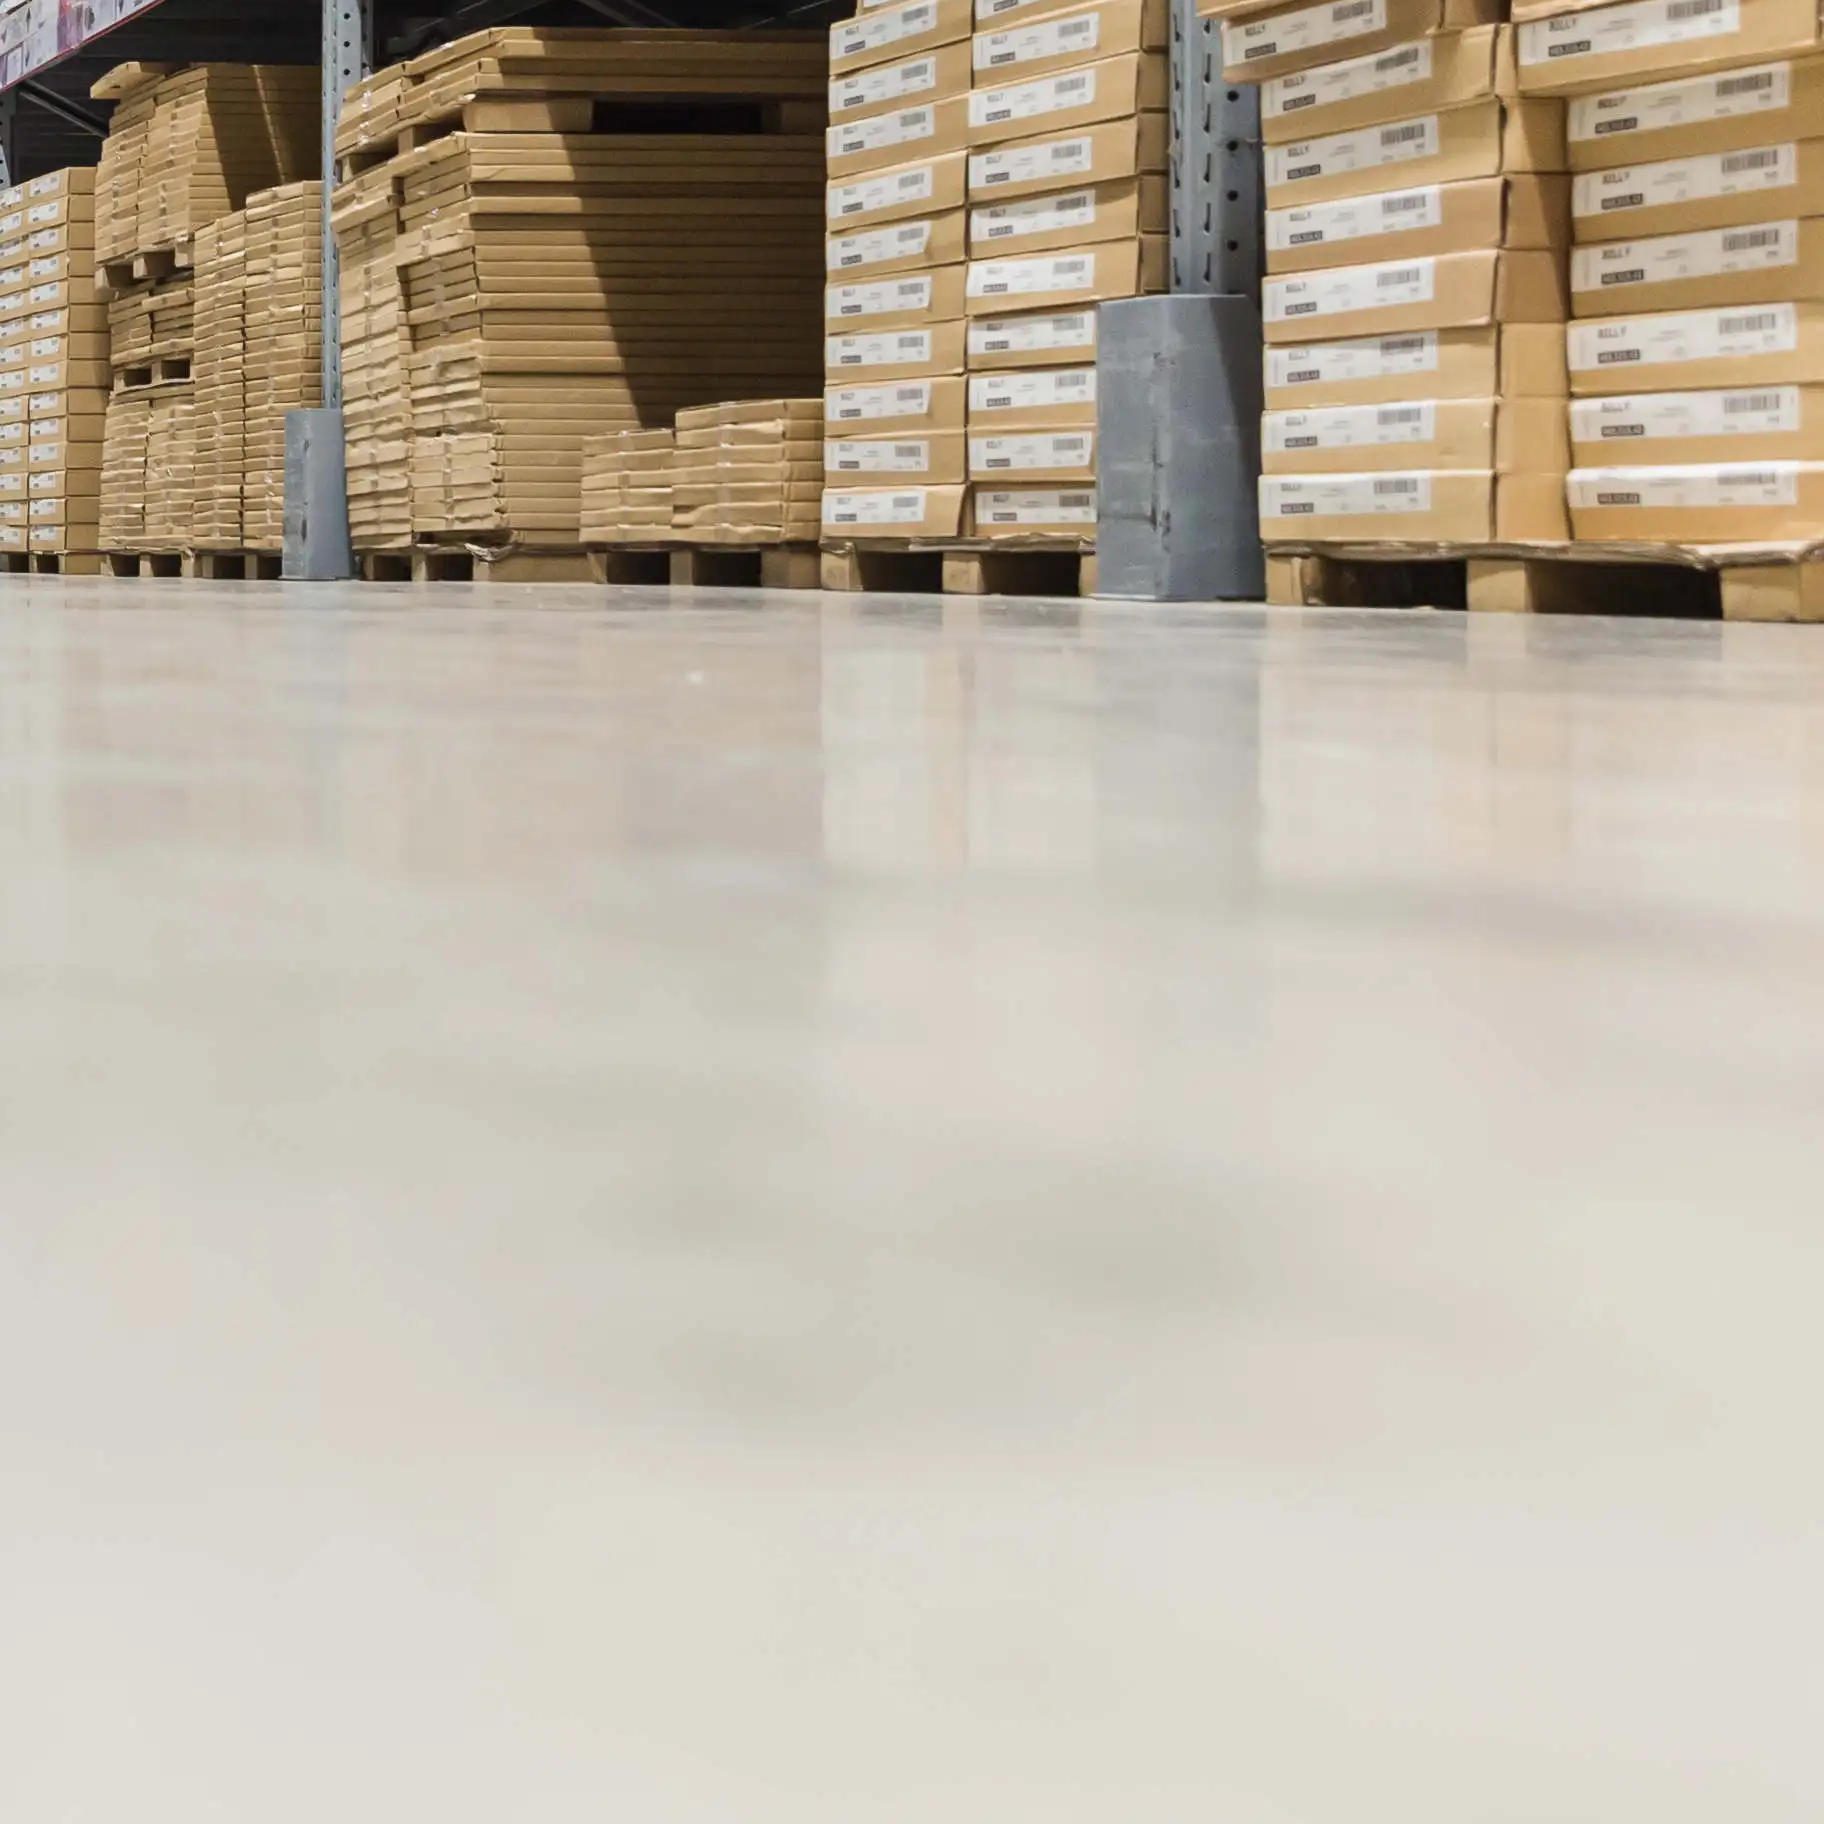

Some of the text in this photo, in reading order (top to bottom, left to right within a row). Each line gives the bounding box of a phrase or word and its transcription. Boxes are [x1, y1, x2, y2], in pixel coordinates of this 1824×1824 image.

[1245, 24, 1267, 38] BILLY
[1548, 17, 1578, 33] BILLY
[1287, 144, 1311, 158] BILLY
[1602, 171, 1631, 185] BILLY
